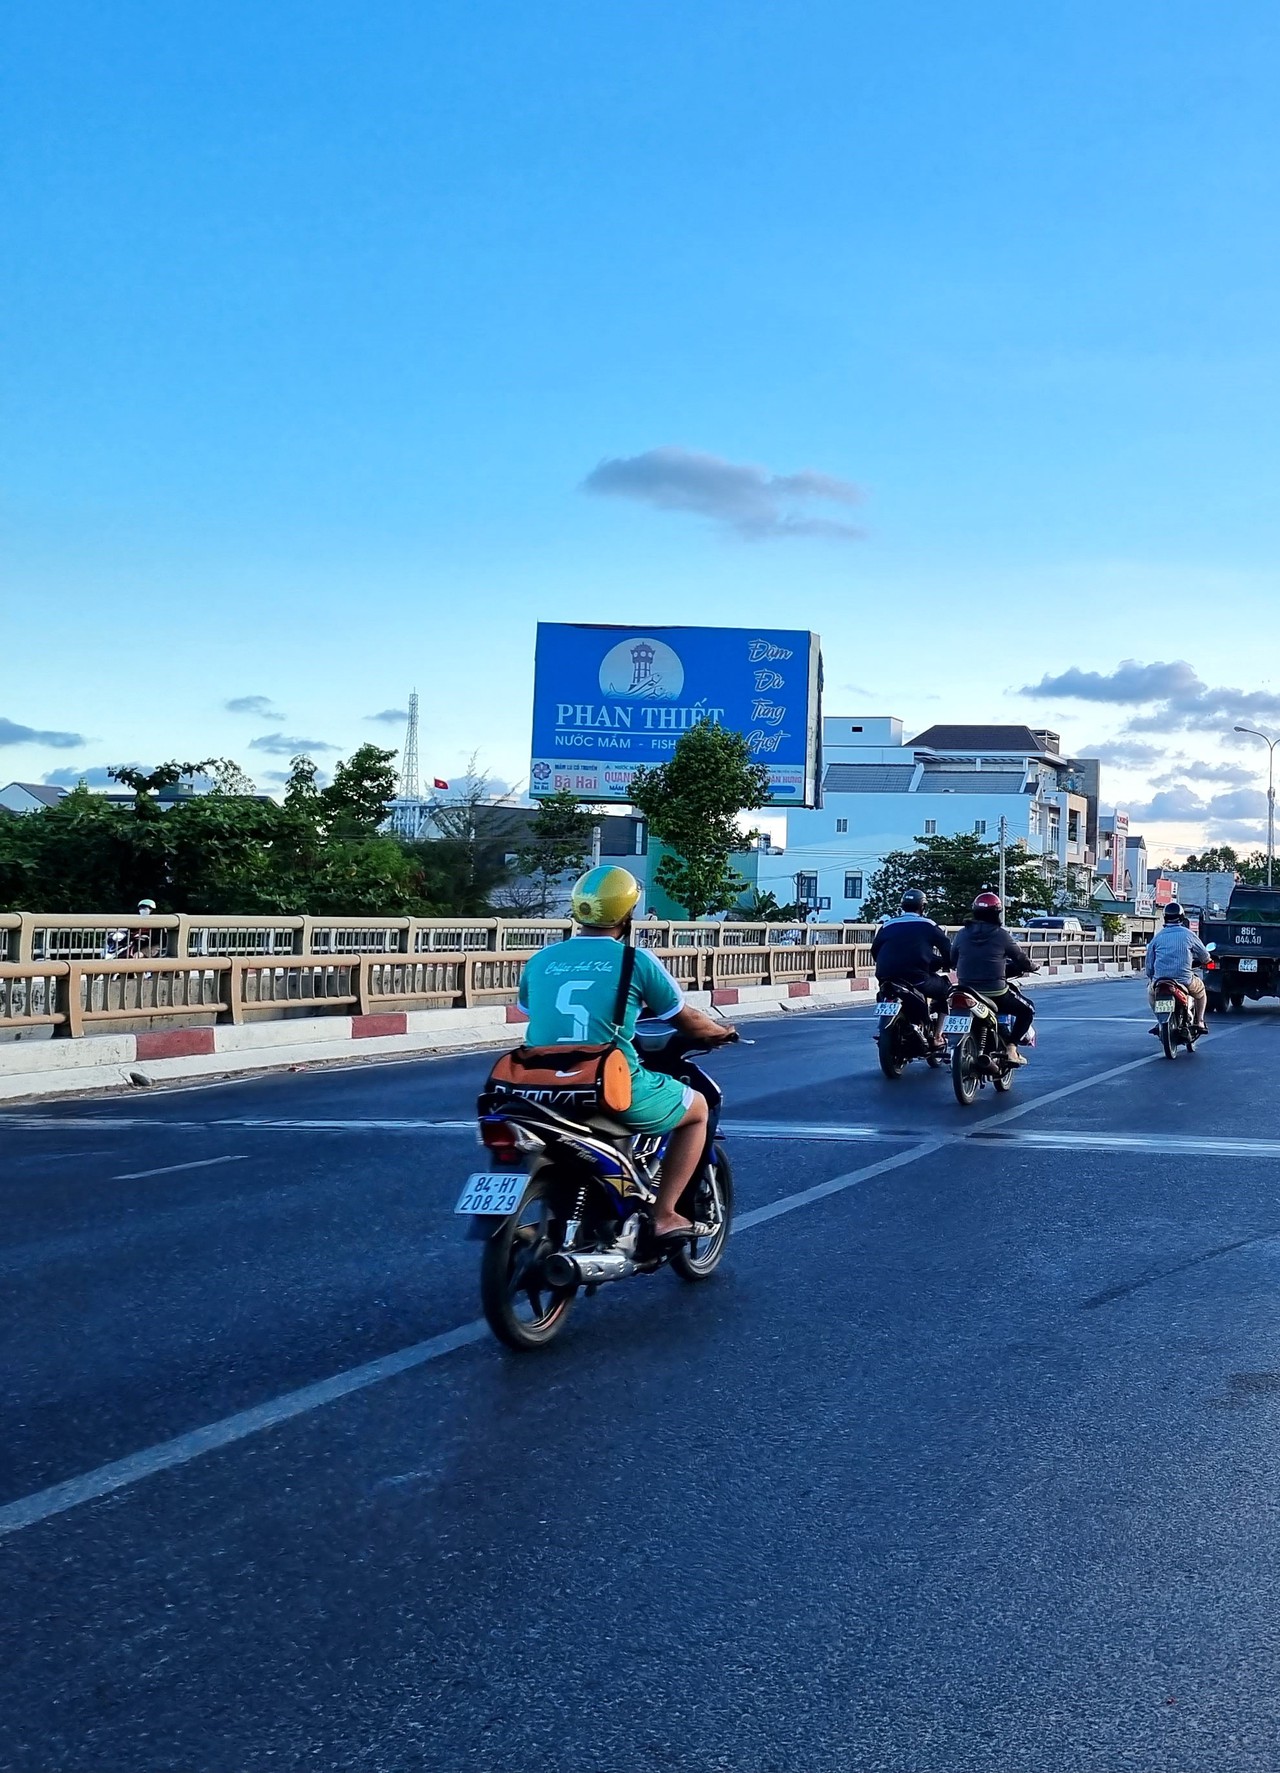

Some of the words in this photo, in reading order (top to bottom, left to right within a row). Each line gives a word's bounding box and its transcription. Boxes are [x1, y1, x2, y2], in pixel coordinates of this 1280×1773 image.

[753, 668, 785, 692] Đà
[555, 703, 633, 728] PHAN
[555, 733, 594, 747] NƯỚC
[598, 734, 631, 749] MẮM
[576, 776, 597, 789] Hai
[555, 981, 596, 1041] 5
[475, 1177, 518, 1193] 84-H1
[461, 1194, 516, 1211] 208.29
